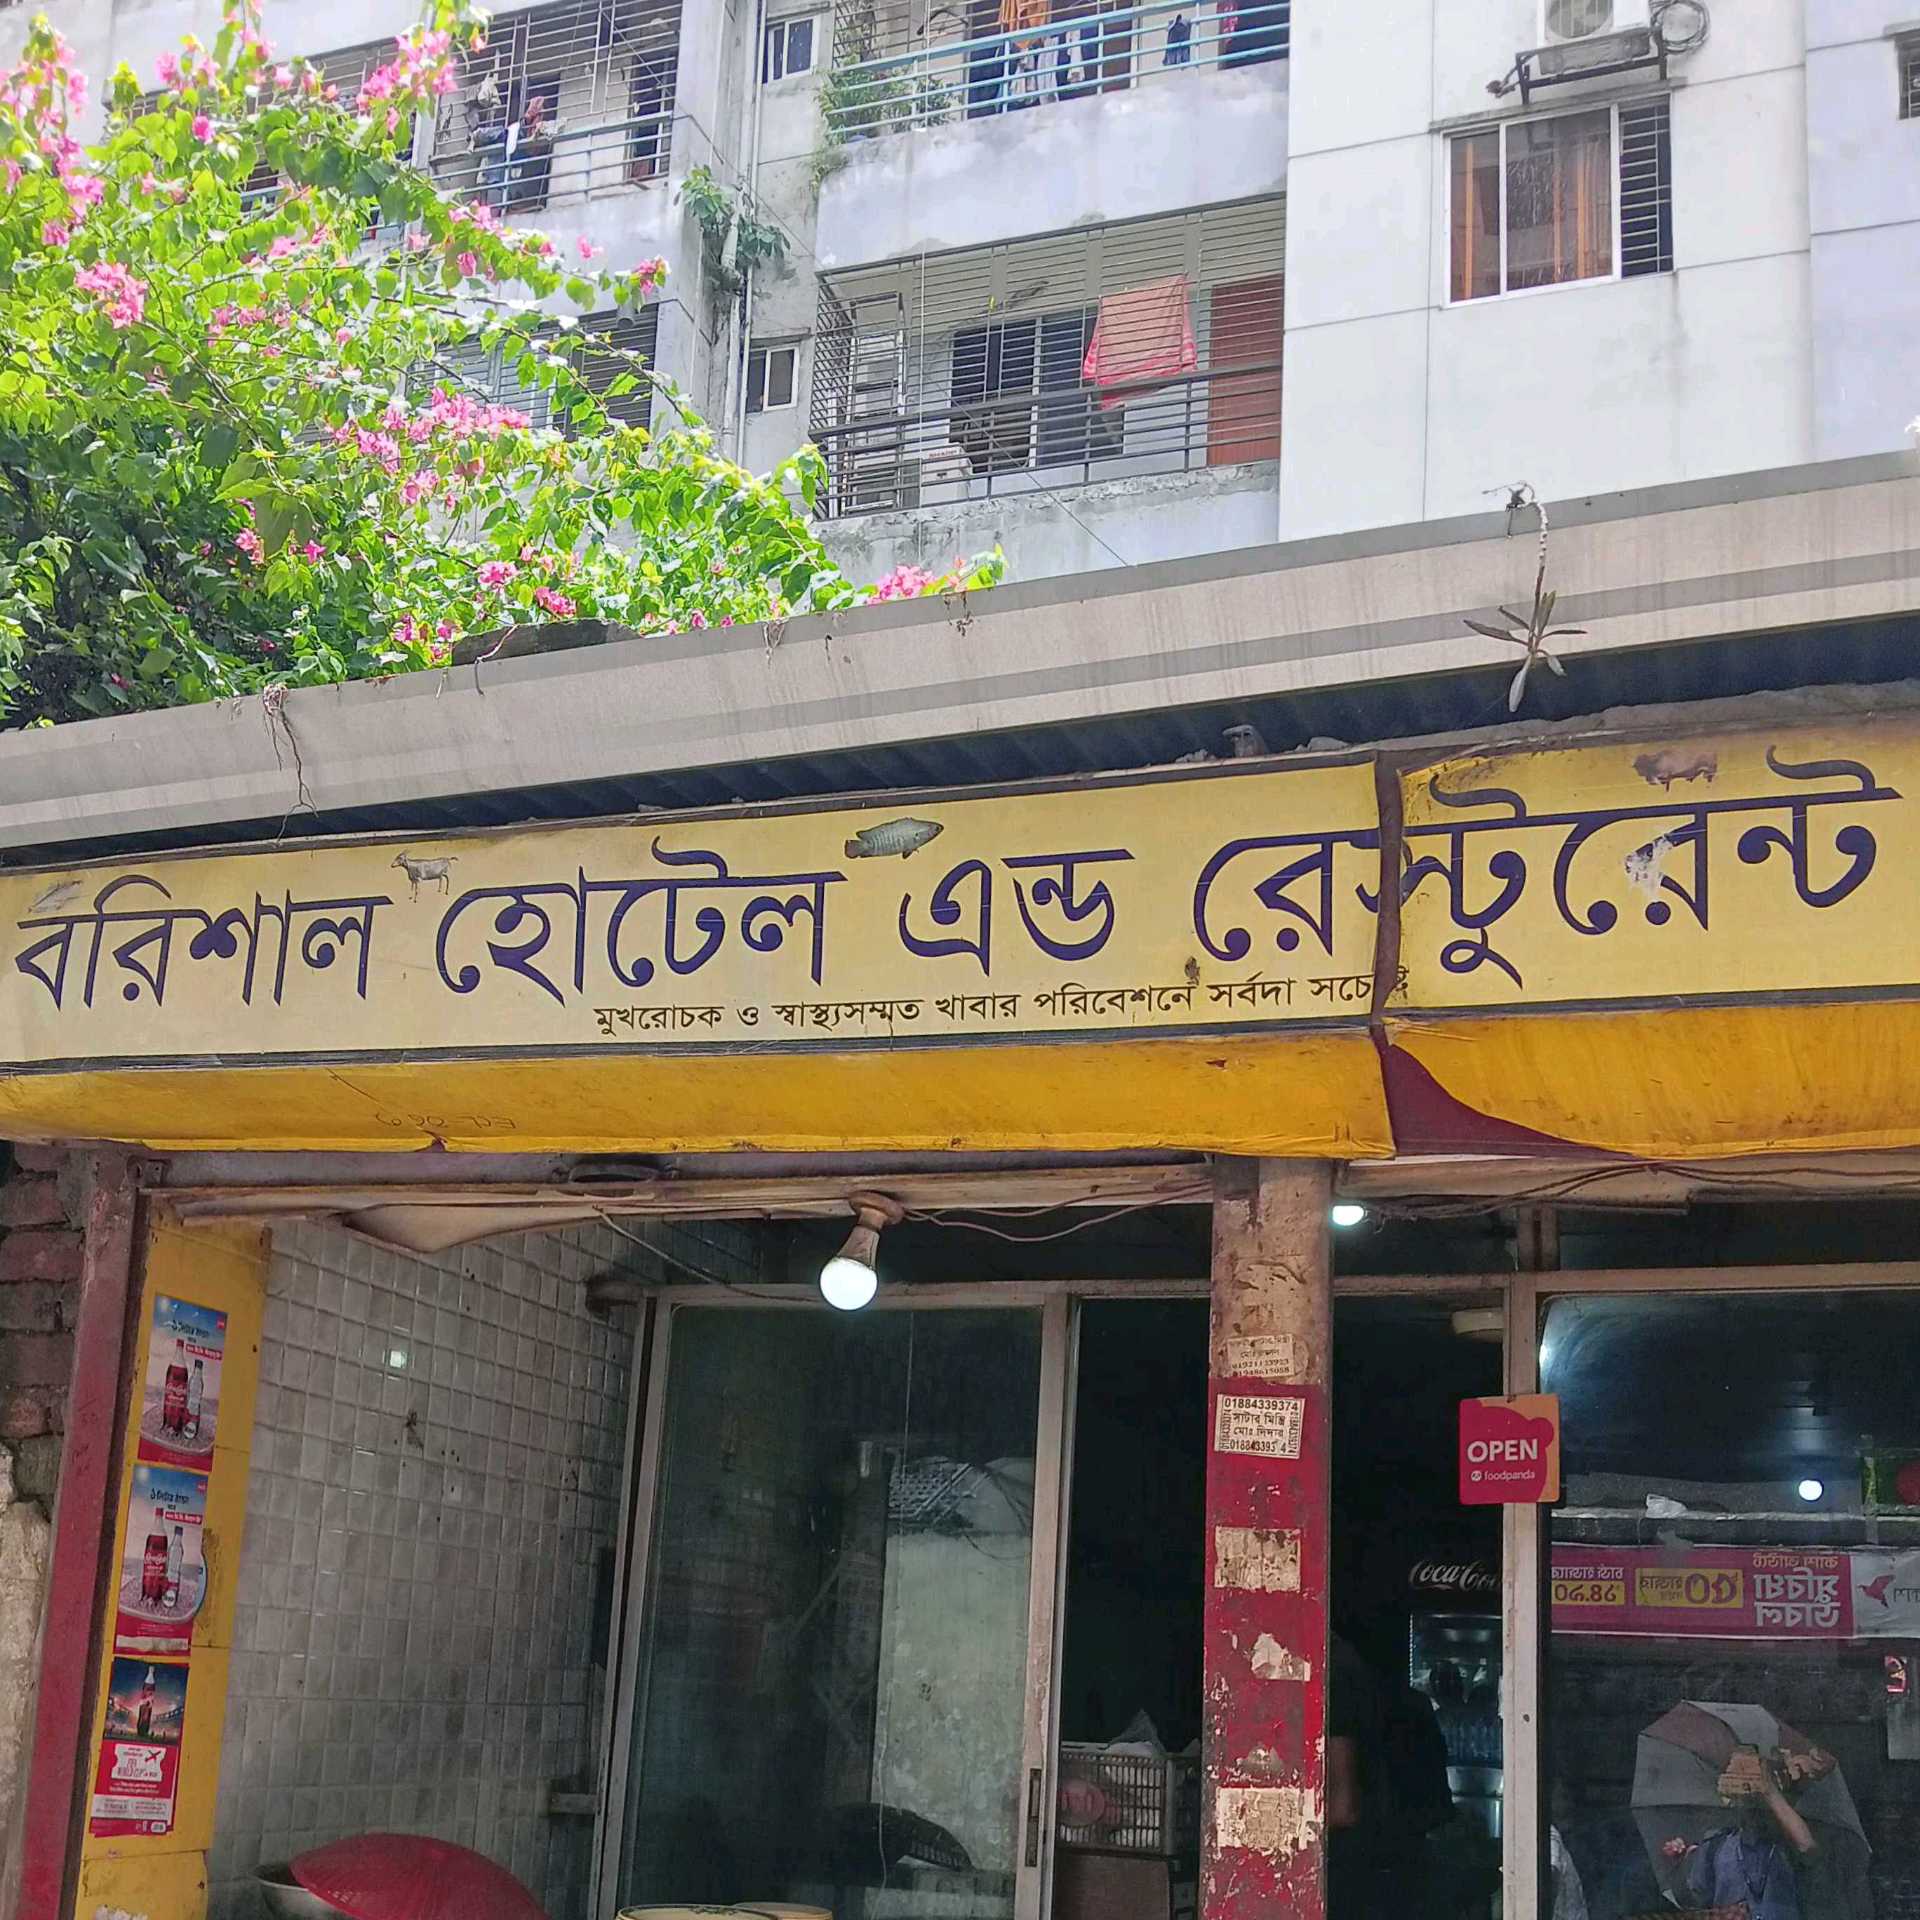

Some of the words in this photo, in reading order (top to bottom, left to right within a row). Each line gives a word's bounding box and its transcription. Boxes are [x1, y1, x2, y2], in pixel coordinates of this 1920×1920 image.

[14, 873, 394, 1011] বরিশাল
[435, 835, 847, 1006] হোটেল
[900, 848, 1136, 977] এন্ড
[593, 1004, 725, 1037] মুখরোচক
[736, 1009, 760, 1026] ও
[934, 993, 1021, 1021] খাবার
[1033, 982, 1196, 1019] পরিবেশনে
[1206, 971, 1298, 1008] সর্বদা
[1224, 1397, 1298, 1411] 01884339374
[1467, 1439, 1538, 1463] OPEN
[1484, 1469, 1535, 1482] foodpanda
